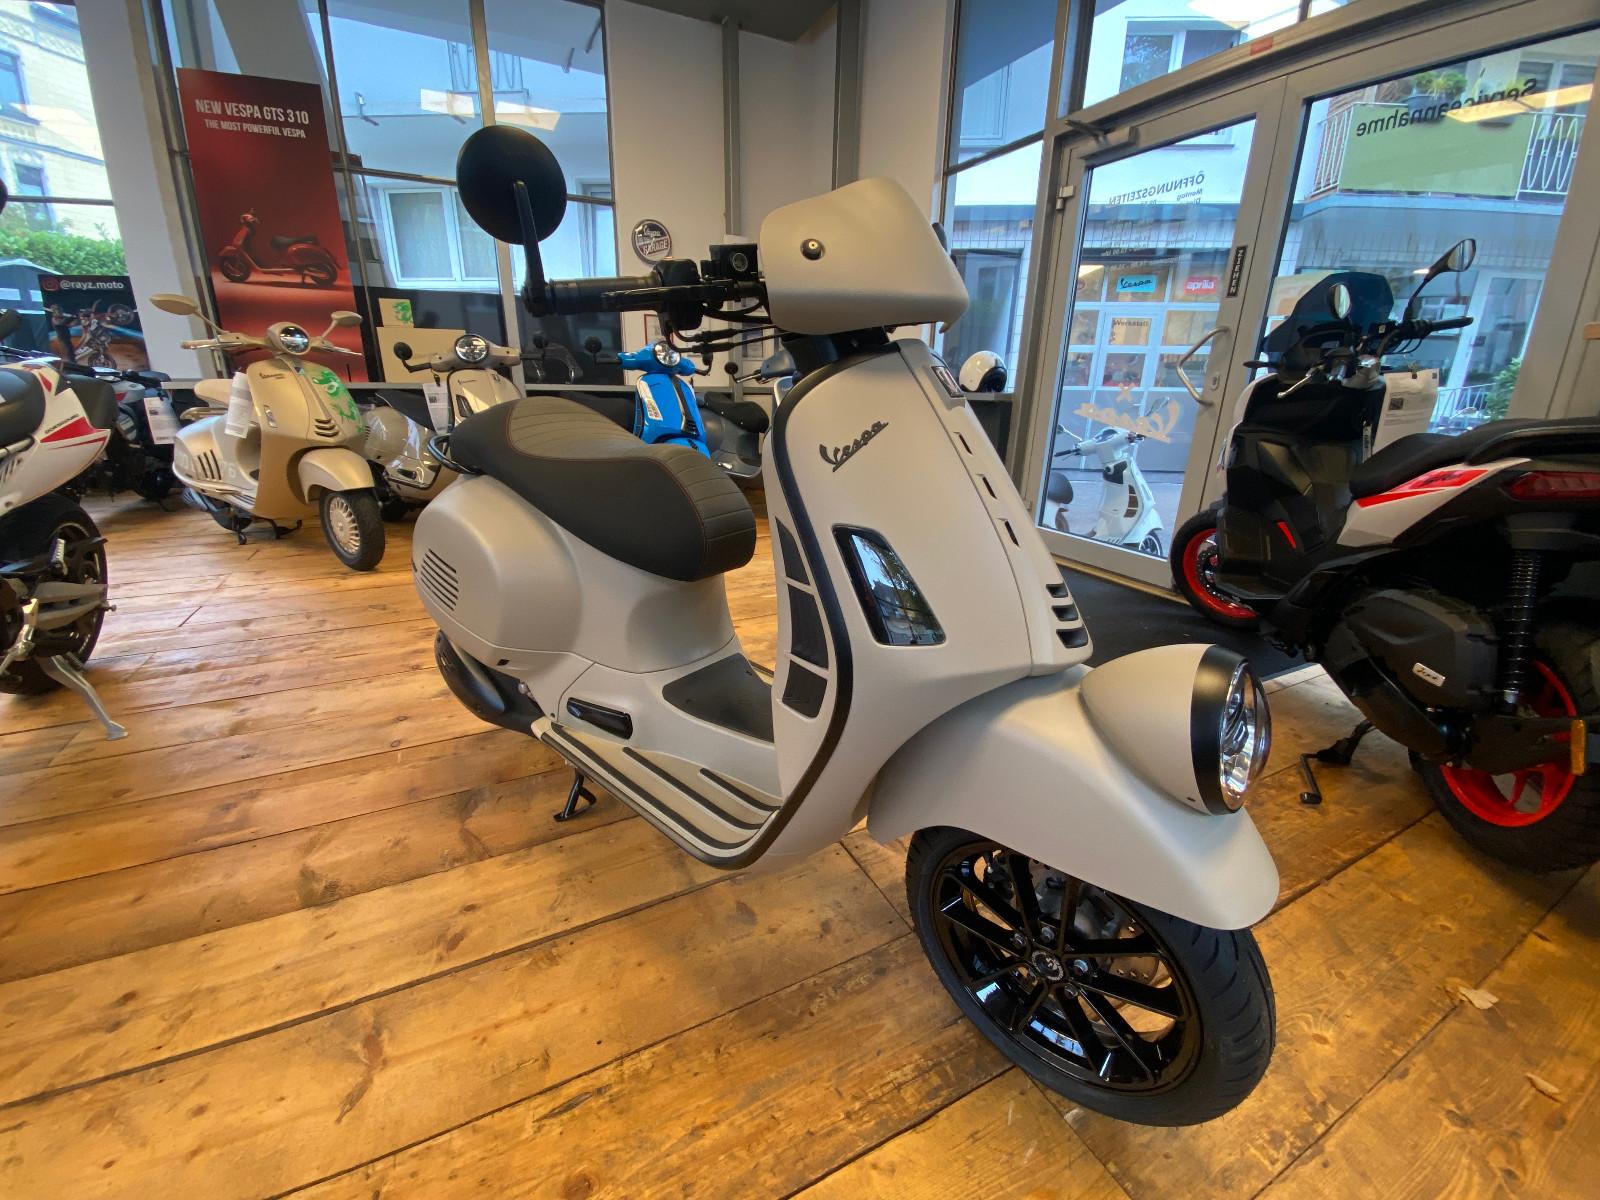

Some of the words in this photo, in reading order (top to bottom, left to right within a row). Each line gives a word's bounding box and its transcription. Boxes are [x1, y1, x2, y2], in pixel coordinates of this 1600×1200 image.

[195, 99, 222, 115] NEW
[223, 101, 262, 119] VESPA
[263, 106, 285, 121] GTS
[287, 109, 310, 125] 310
[204, 118, 219, 129] THE
[220, 120, 241, 131] MOST
[242, 122, 281, 136] POWERFUL
[282, 127, 306, 139] VESPA
[643, 238, 669, 255] GARAGE
[1230, 249, 1244, 293] ZIEHEN
[60, 279, 125, 290] @rayz.moto
[1120, 278, 1153, 290] Vespa
[1187, 279, 1215, 292] aprilia
[819, 420, 889, 473] Vespa
